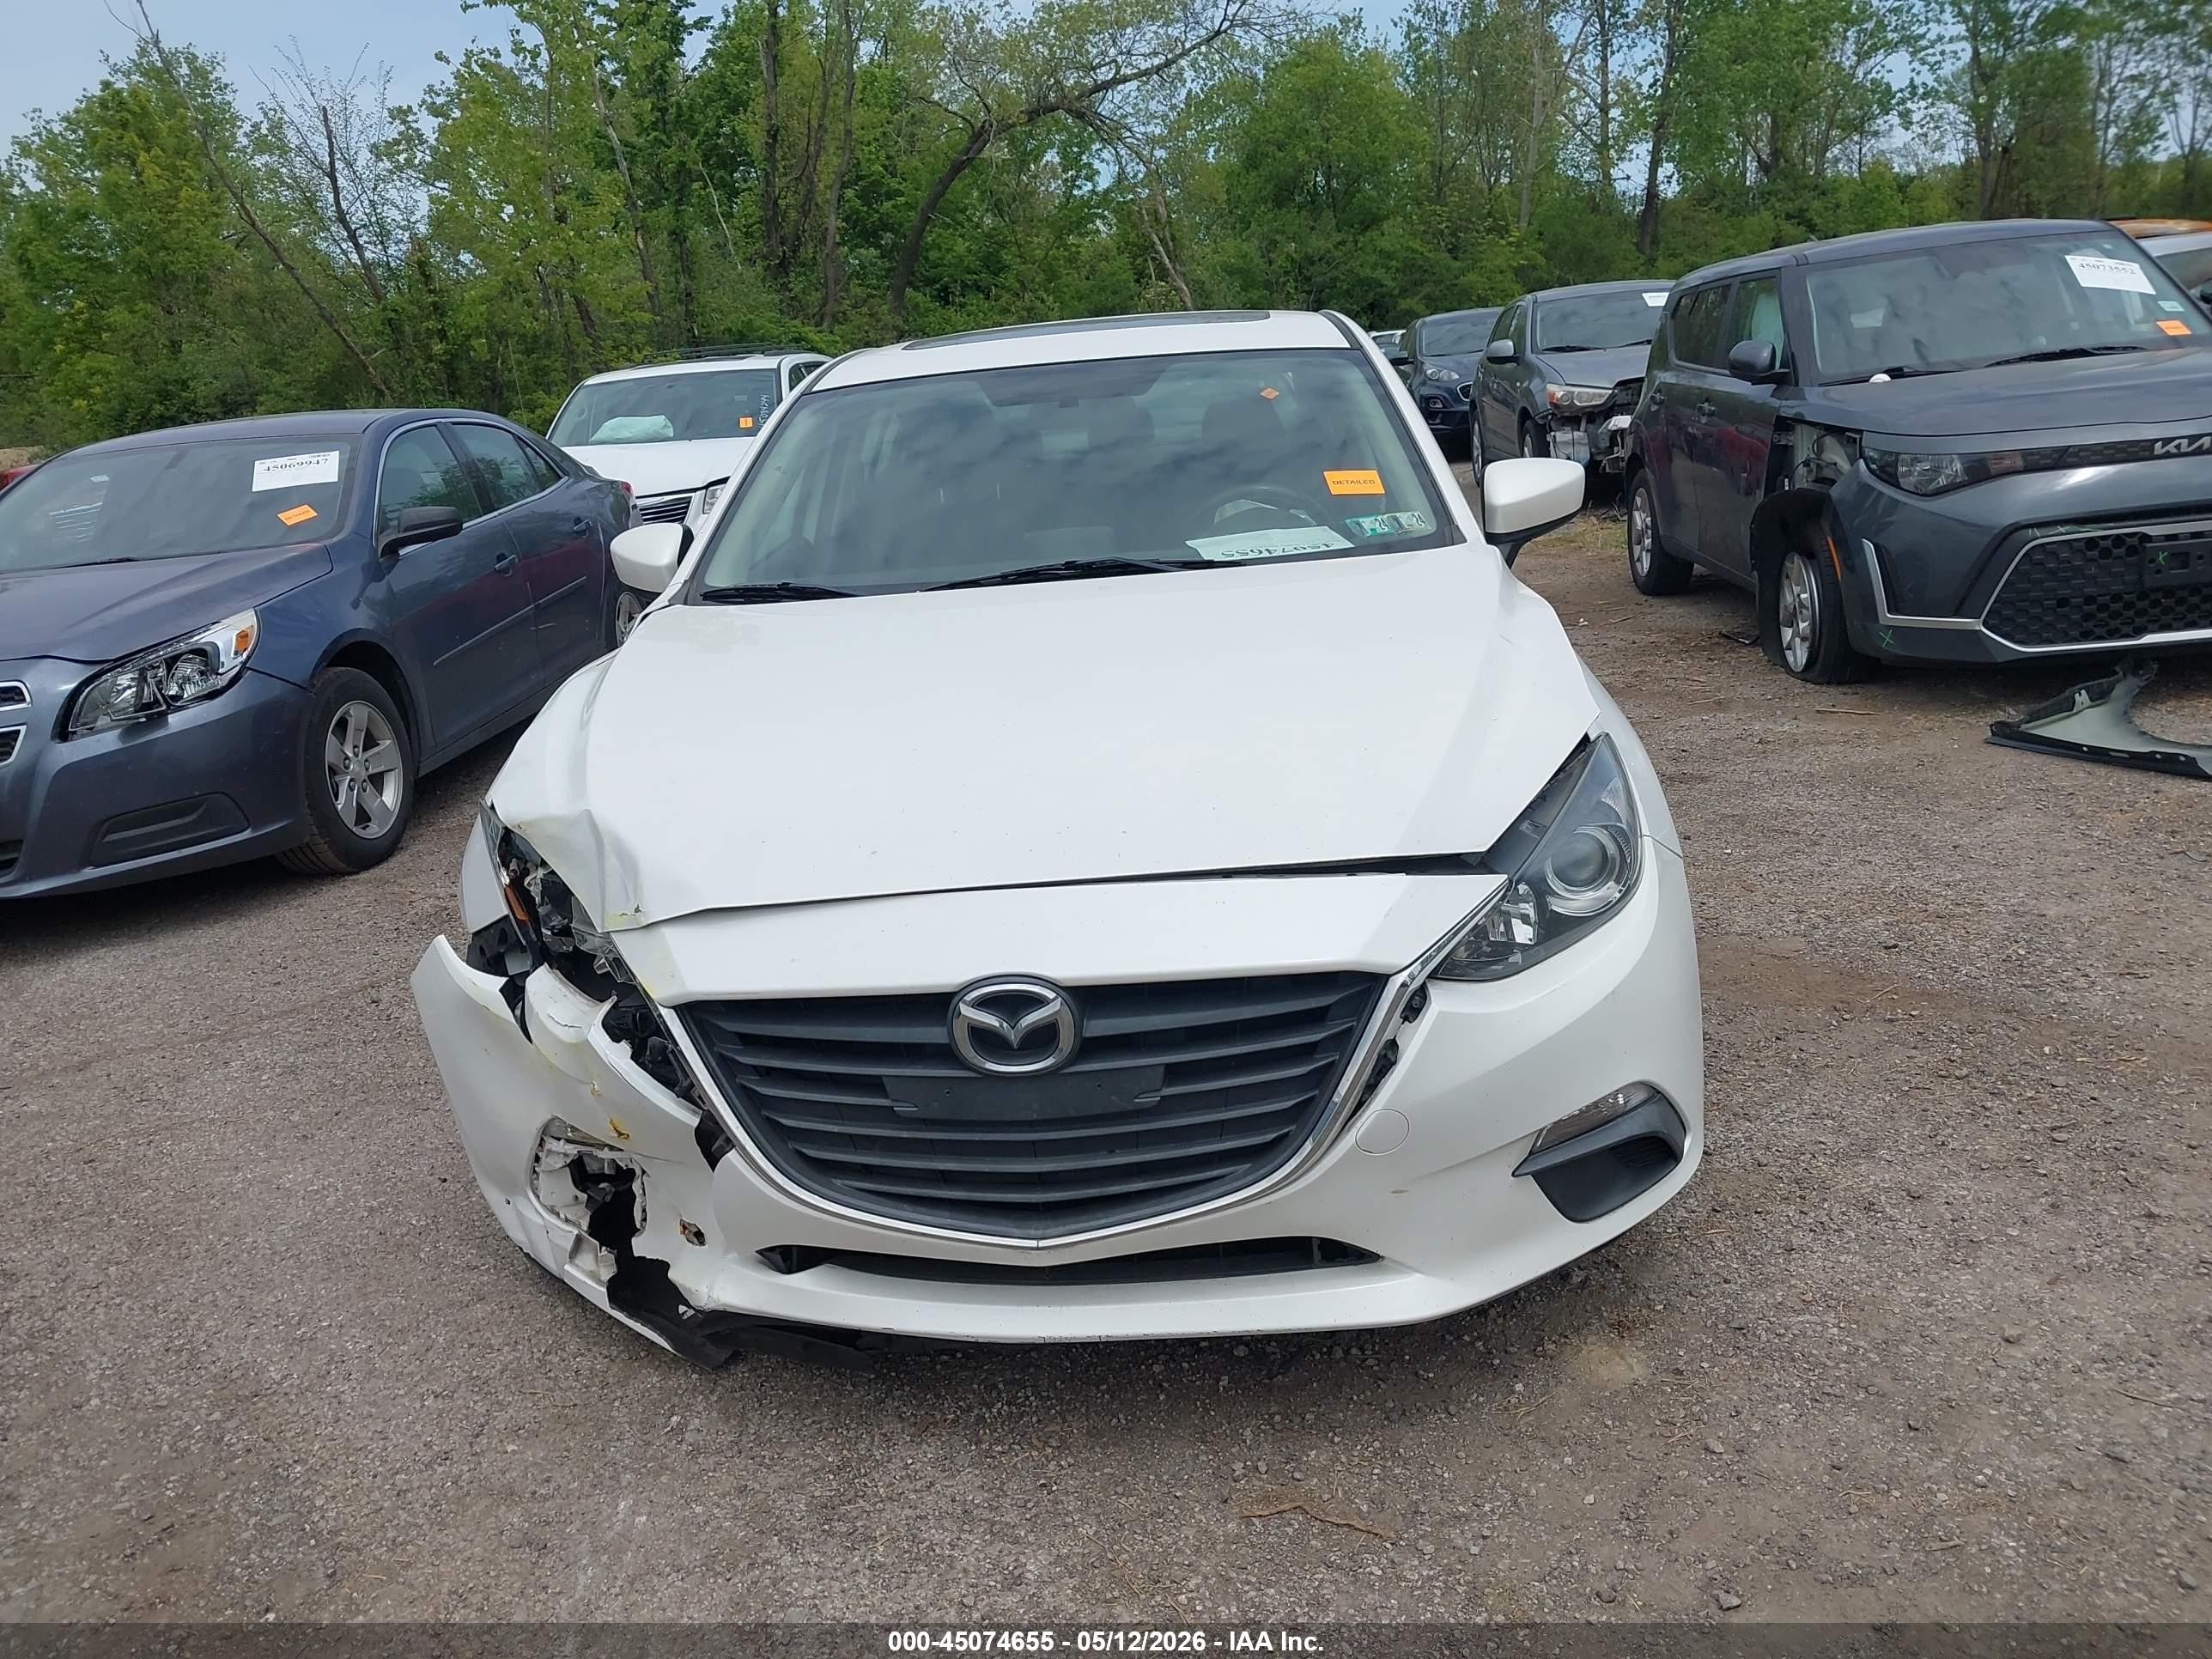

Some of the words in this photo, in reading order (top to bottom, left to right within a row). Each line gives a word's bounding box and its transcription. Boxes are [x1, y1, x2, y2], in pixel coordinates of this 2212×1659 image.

[2154, 436, 2212, 455] KIA
[263, 459, 328, 471] 45069947
[1220, 542, 1335, 558] 45074655
